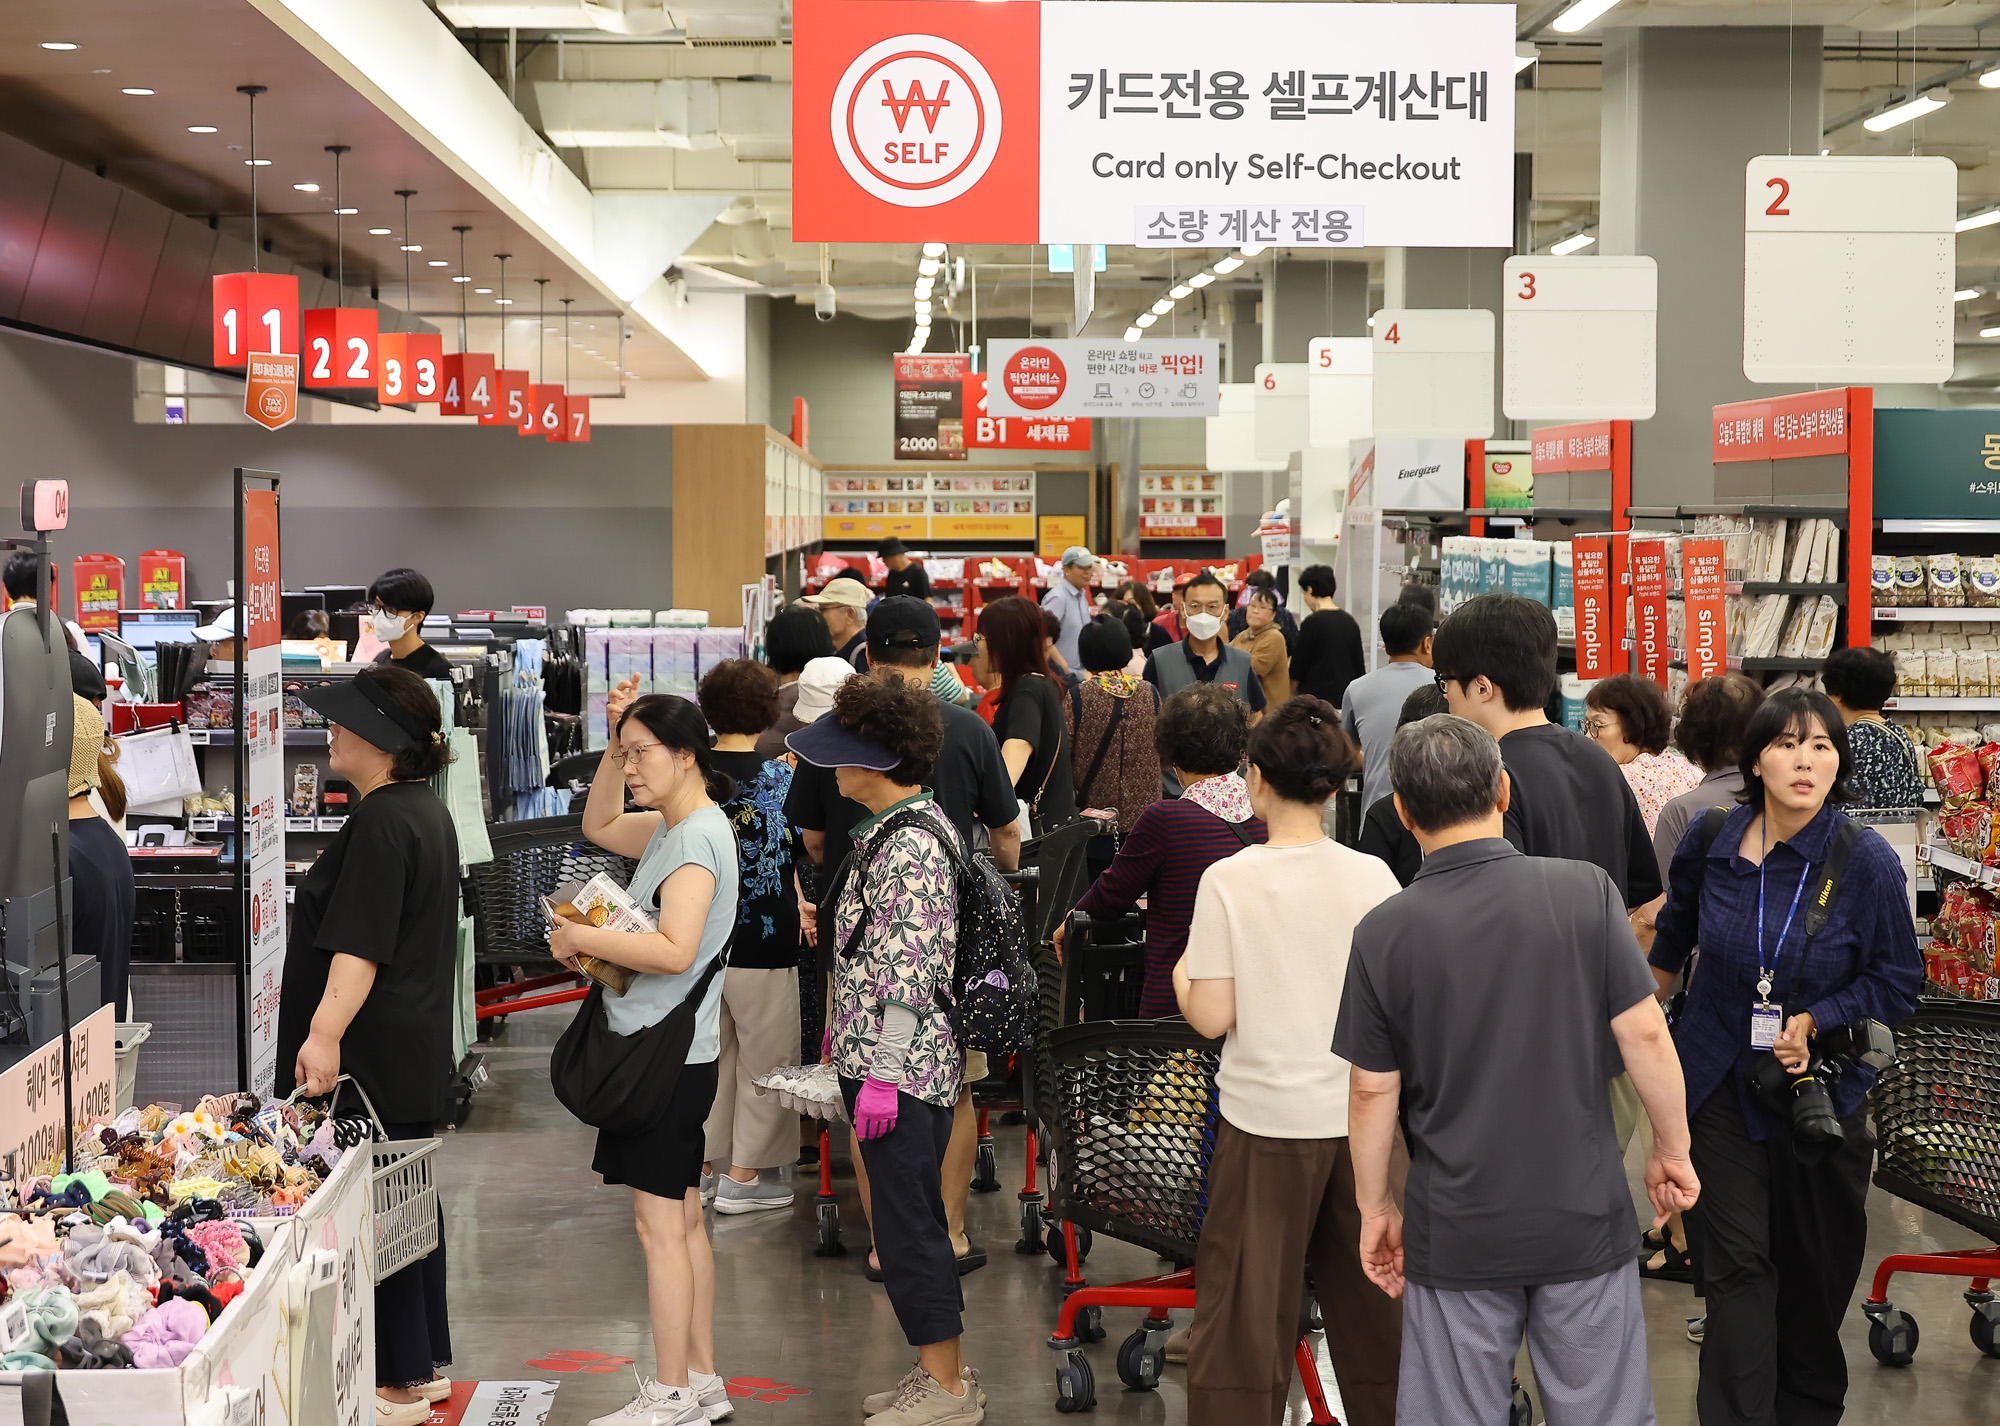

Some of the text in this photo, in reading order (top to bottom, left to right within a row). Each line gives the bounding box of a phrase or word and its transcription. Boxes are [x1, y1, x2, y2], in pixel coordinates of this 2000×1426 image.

[1067, 69, 1487, 122] 카드전용 셀프계산대
[884, 142, 949, 163] SELF
[1092, 152, 1461, 185] Card only Self-Checkout
[1766, 178, 1790, 215] 2
[1147, 209, 1353, 242] 소량 계산 전용
[1518, 272, 1536, 300] 3
[223, 309, 237, 355] 1
[261, 309, 281, 355] 1
[1384, 322, 1400, 344] 4
[312, 337, 331, 379] 2
[346, 337, 370, 379] 2
[1019, 357, 1050, 369] 온라인
[1087, 350, 1153, 361] 온라인 쇼핑 하고
[1087, 363, 1159, 375] 편한 시간에 바로
[1161, 354, 1203, 375] 픽업!
[1320, 349, 1332, 367] 5
[252, 362, 295, 378] 即刻退税
[385, 359, 402, 396] 3
[416, 359, 436, 396] 3
[1009, 372, 1061, 385] 픽업서비스
[1264, 373, 1276, 390] 6
[265, 397, 282, 406] TAX
[445, 377, 460, 408] 4
[471, 376, 490, 407] 4
[508, 390, 523, 419] 5
[541, 403, 558, 429] 6
[573, 413, 585, 437] 7
[976, 417, 1007, 442] B1
[1719, 407, 1844, 446] 오늘도 특별한 혜택 바로 담는 오늘의 추천상품
[1026, 424, 1070, 442] 세제류
[1397, 463, 1441, 480] Energizer
[56, 489, 66, 518] 04
[1580, 560, 1599, 568] 품질만
[1585, 551, 1603, 559] 필요한
[1642, 556, 1660, 564] 필요한
[1697, 556, 1719, 565] 필요한
[1577, 568, 1604, 576] 심플하게!
[1635, 573, 1662, 582] 심플하게!
[1639, 565, 1657, 573] 품질만
[1689, 575, 1720, 585] 심플하게!
[1693, 566, 1716, 575] 품질만
[250, 581, 277, 626] 셀프계산대
[1581, 597, 1602, 670] simplus
[1641, 604, 1660, 681] simplus
[1695, 609, 1718, 678] simplu
[1817, 878, 1834, 907] Nikon
[26, 1028, 89, 1113] 헤어 액서리
[342, 1237, 356, 1315] 헤어
[336, 1306, 363, 1415] 액세서리
[491, 1386, 531, 1419] 셀프계산대
